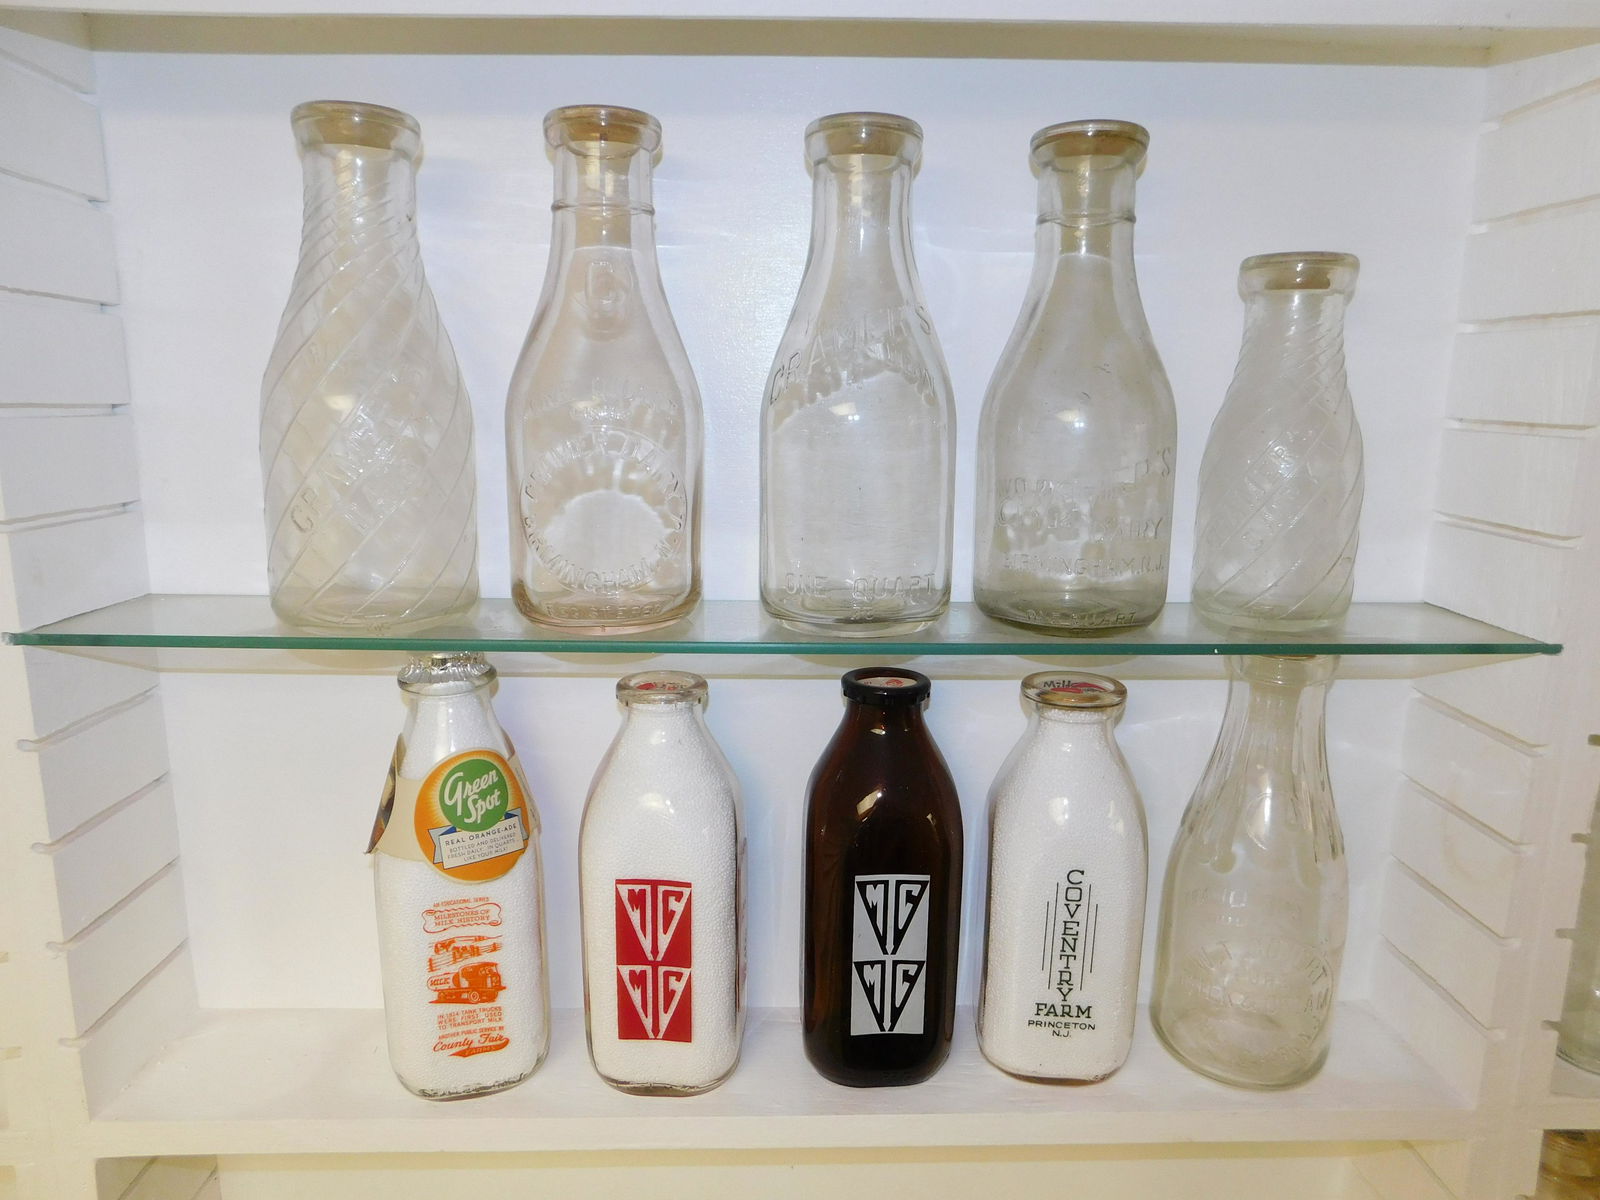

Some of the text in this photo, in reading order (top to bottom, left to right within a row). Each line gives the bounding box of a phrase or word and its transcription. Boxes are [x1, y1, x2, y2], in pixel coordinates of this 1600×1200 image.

[444, 769, 499, 817] Green
[464, 788, 501, 824] Spot
[445, 823, 517, 846] REAL ORANGE-ADE
[449, 832, 516, 854] BOTTLED AND DELIVERED
[447, 851, 466, 860] FRESH
[463, 854, 476, 862] LIKE
[477, 850, 494, 859] YOUR
[434, 910, 479, 921] MILESTONES
[434, 915, 491, 927] MILK HISTORY
[1056, 869, 1085, 1002] COVENTRY
[430, 977, 450, 986] MILK
[1034, 1002, 1092, 1019] FARM
[437, 1017, 457, 1026] WERE
[461, 1013, 480, 1021] FIRST
[449, 1018, 484, 1029] TRANSPORT
[1027, 1019, 1096, 1030] PRINCETON
[438, 1032, 460, 1040] ANOTHER
[1052, 1029, 1072, 1038] N.J.
[433, 1033, 504, 1053] County Fair
